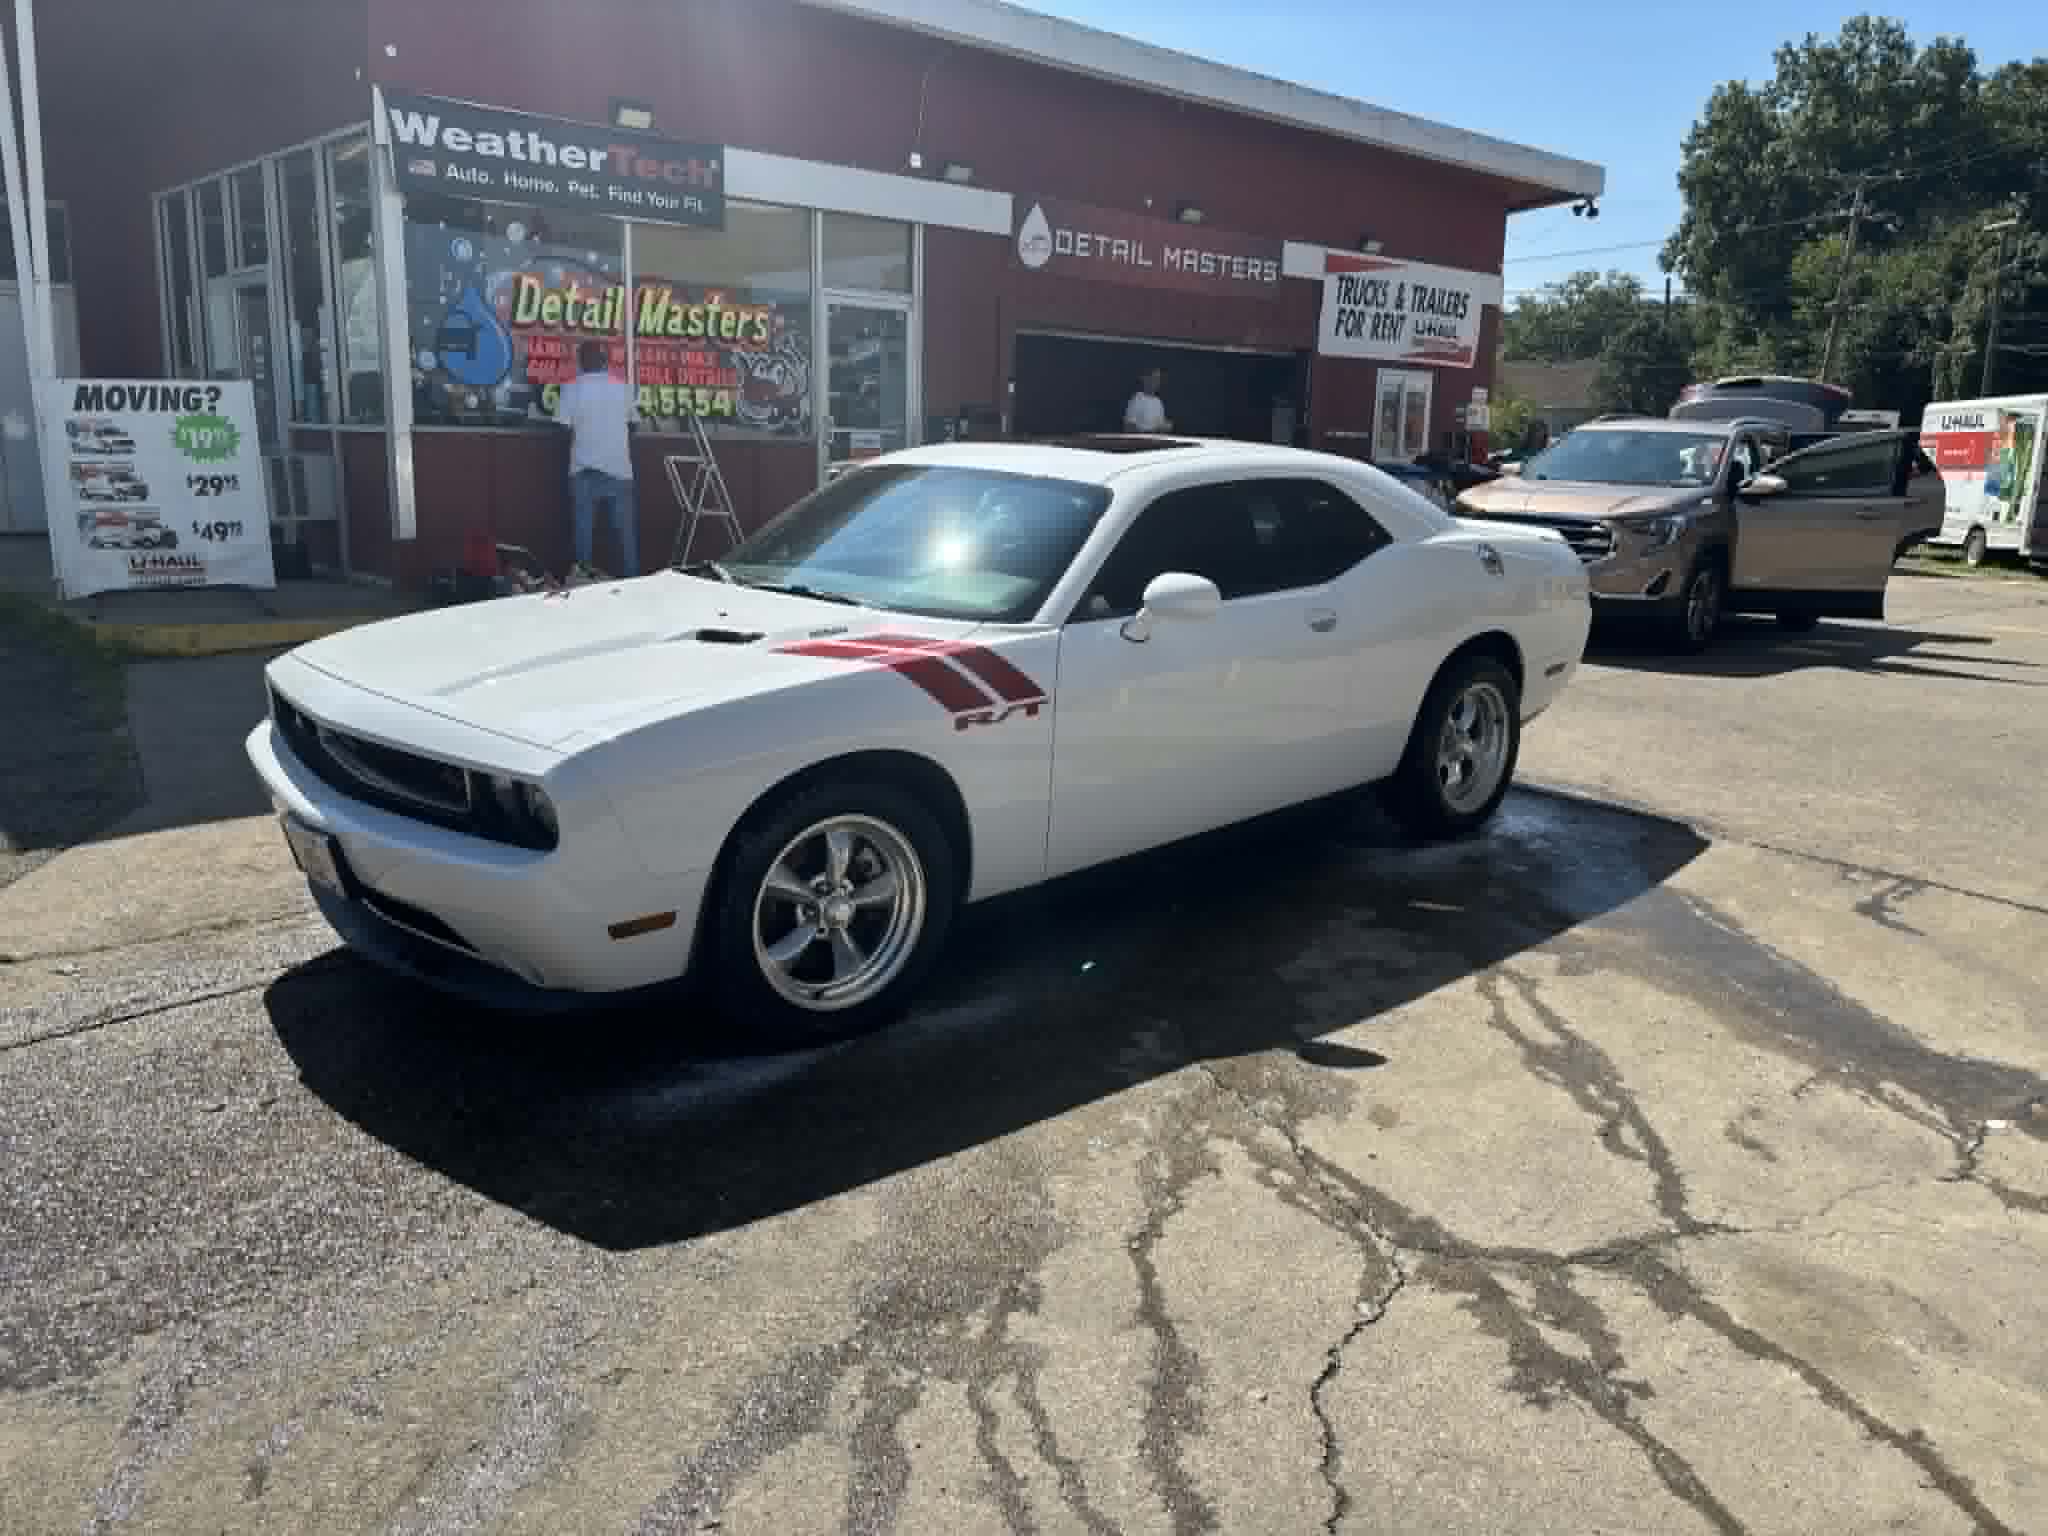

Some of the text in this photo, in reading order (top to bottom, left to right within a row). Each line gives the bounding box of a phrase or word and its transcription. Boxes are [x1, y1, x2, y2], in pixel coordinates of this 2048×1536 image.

[646, 190, 680, 209] Your
[1055, 228, 1280, 282] DETAIL MASTERS
[512, 274, 769, 341] Detail Masters
[1336, 273, 1471, 320] TRUCKS & TRAILERS
[1334, 308, 1408, 344] FOR RENT
[72, 384, 223, 413] MOVING?
